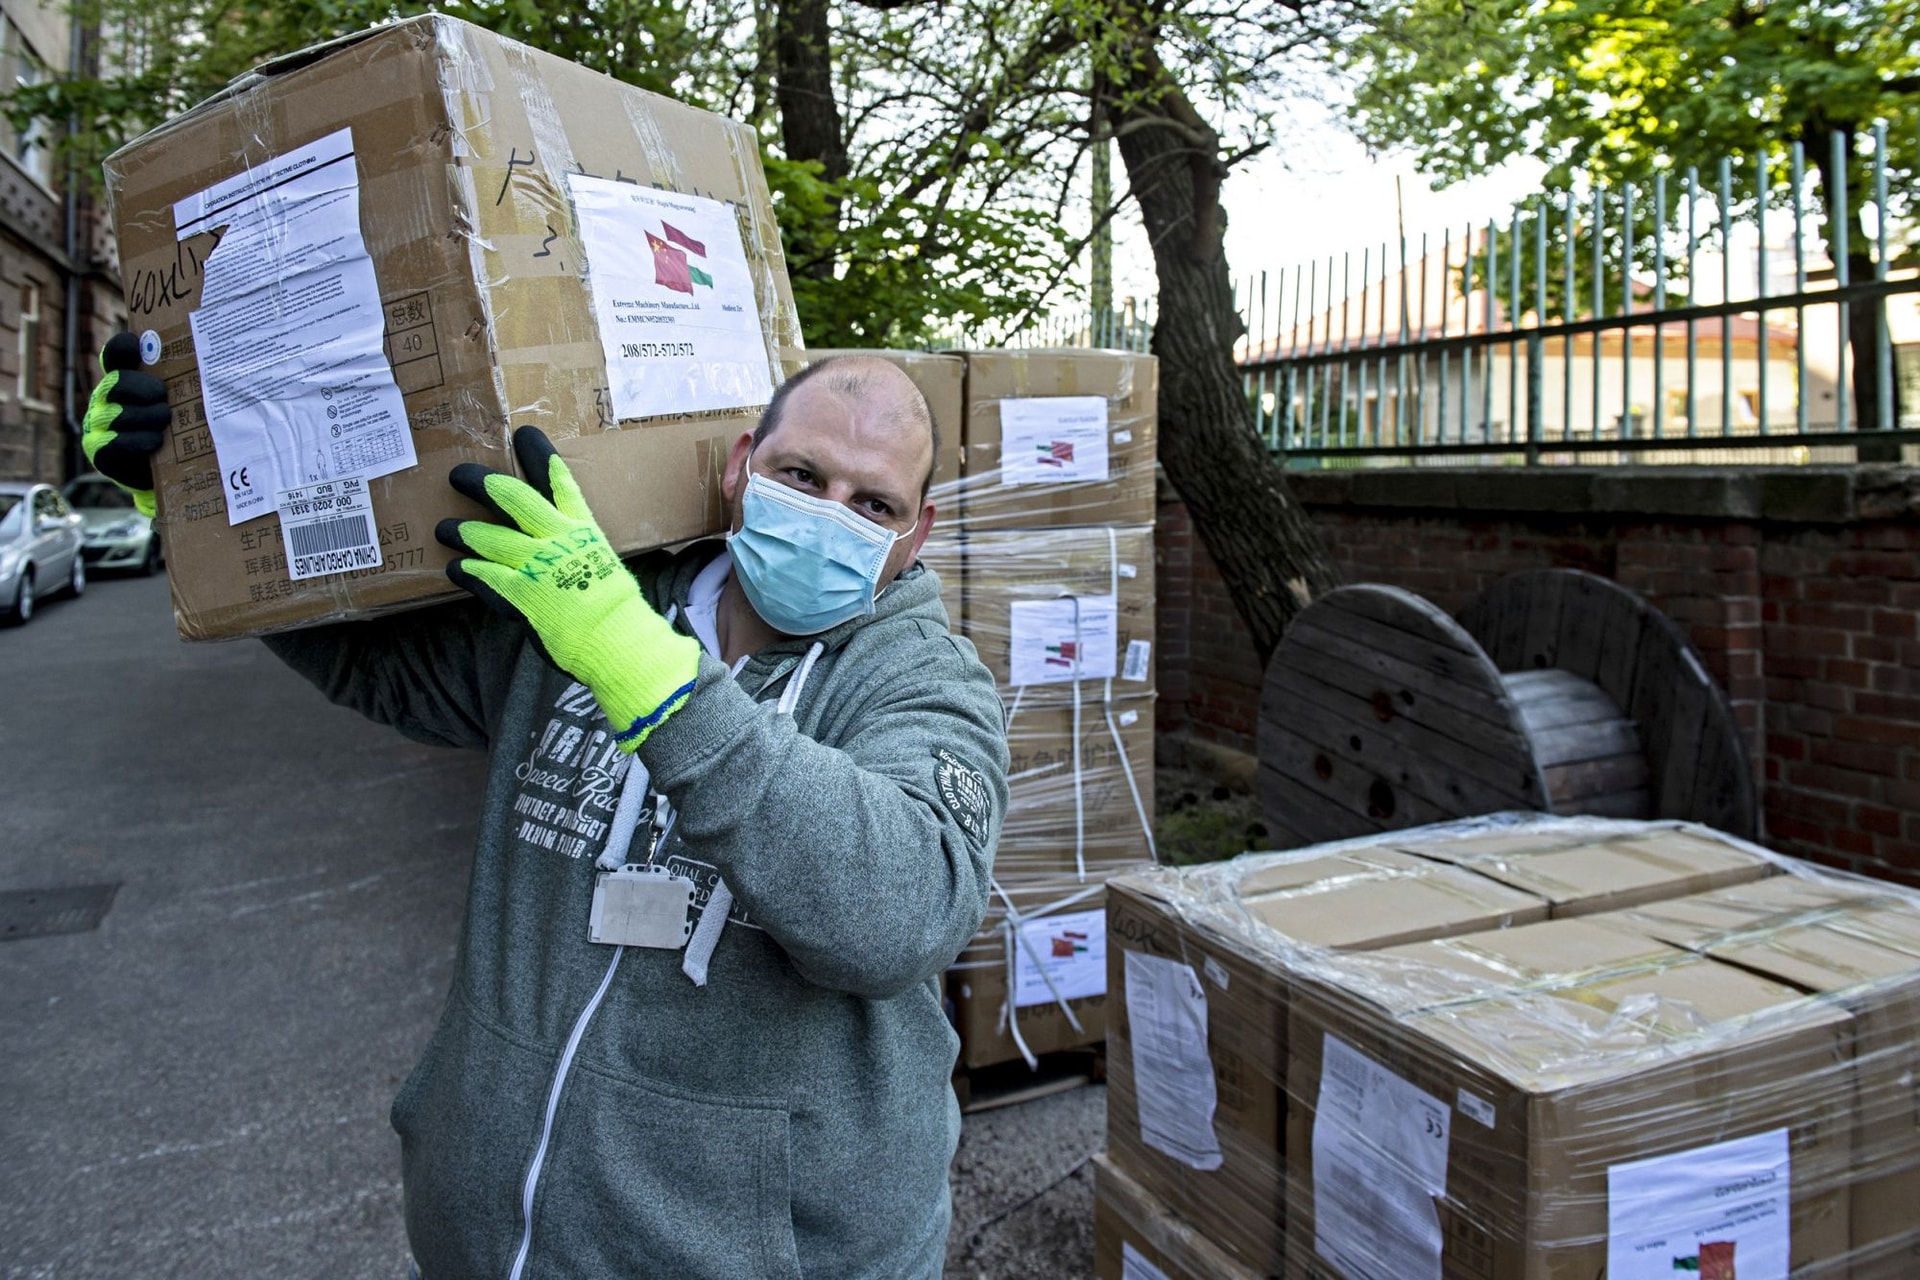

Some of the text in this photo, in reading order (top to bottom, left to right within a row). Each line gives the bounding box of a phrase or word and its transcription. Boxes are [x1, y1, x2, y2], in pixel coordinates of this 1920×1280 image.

[391, 300, 425, 326] 总数
[403, 333, 422, 353] 40
[622, 343, 695, 358] 208/572-572/572
[288, 479, 360, 500] PVG BUD 1416
[291, 497, 352, 516] 000 2020 3131
[295, 546, 377, 576] CHINA CARGO AIRLINES
[515, 746, 575, 793] Speed
[514, 793, 557, 823] VINTAGE
[517, 821, 558, 850] DENIM
